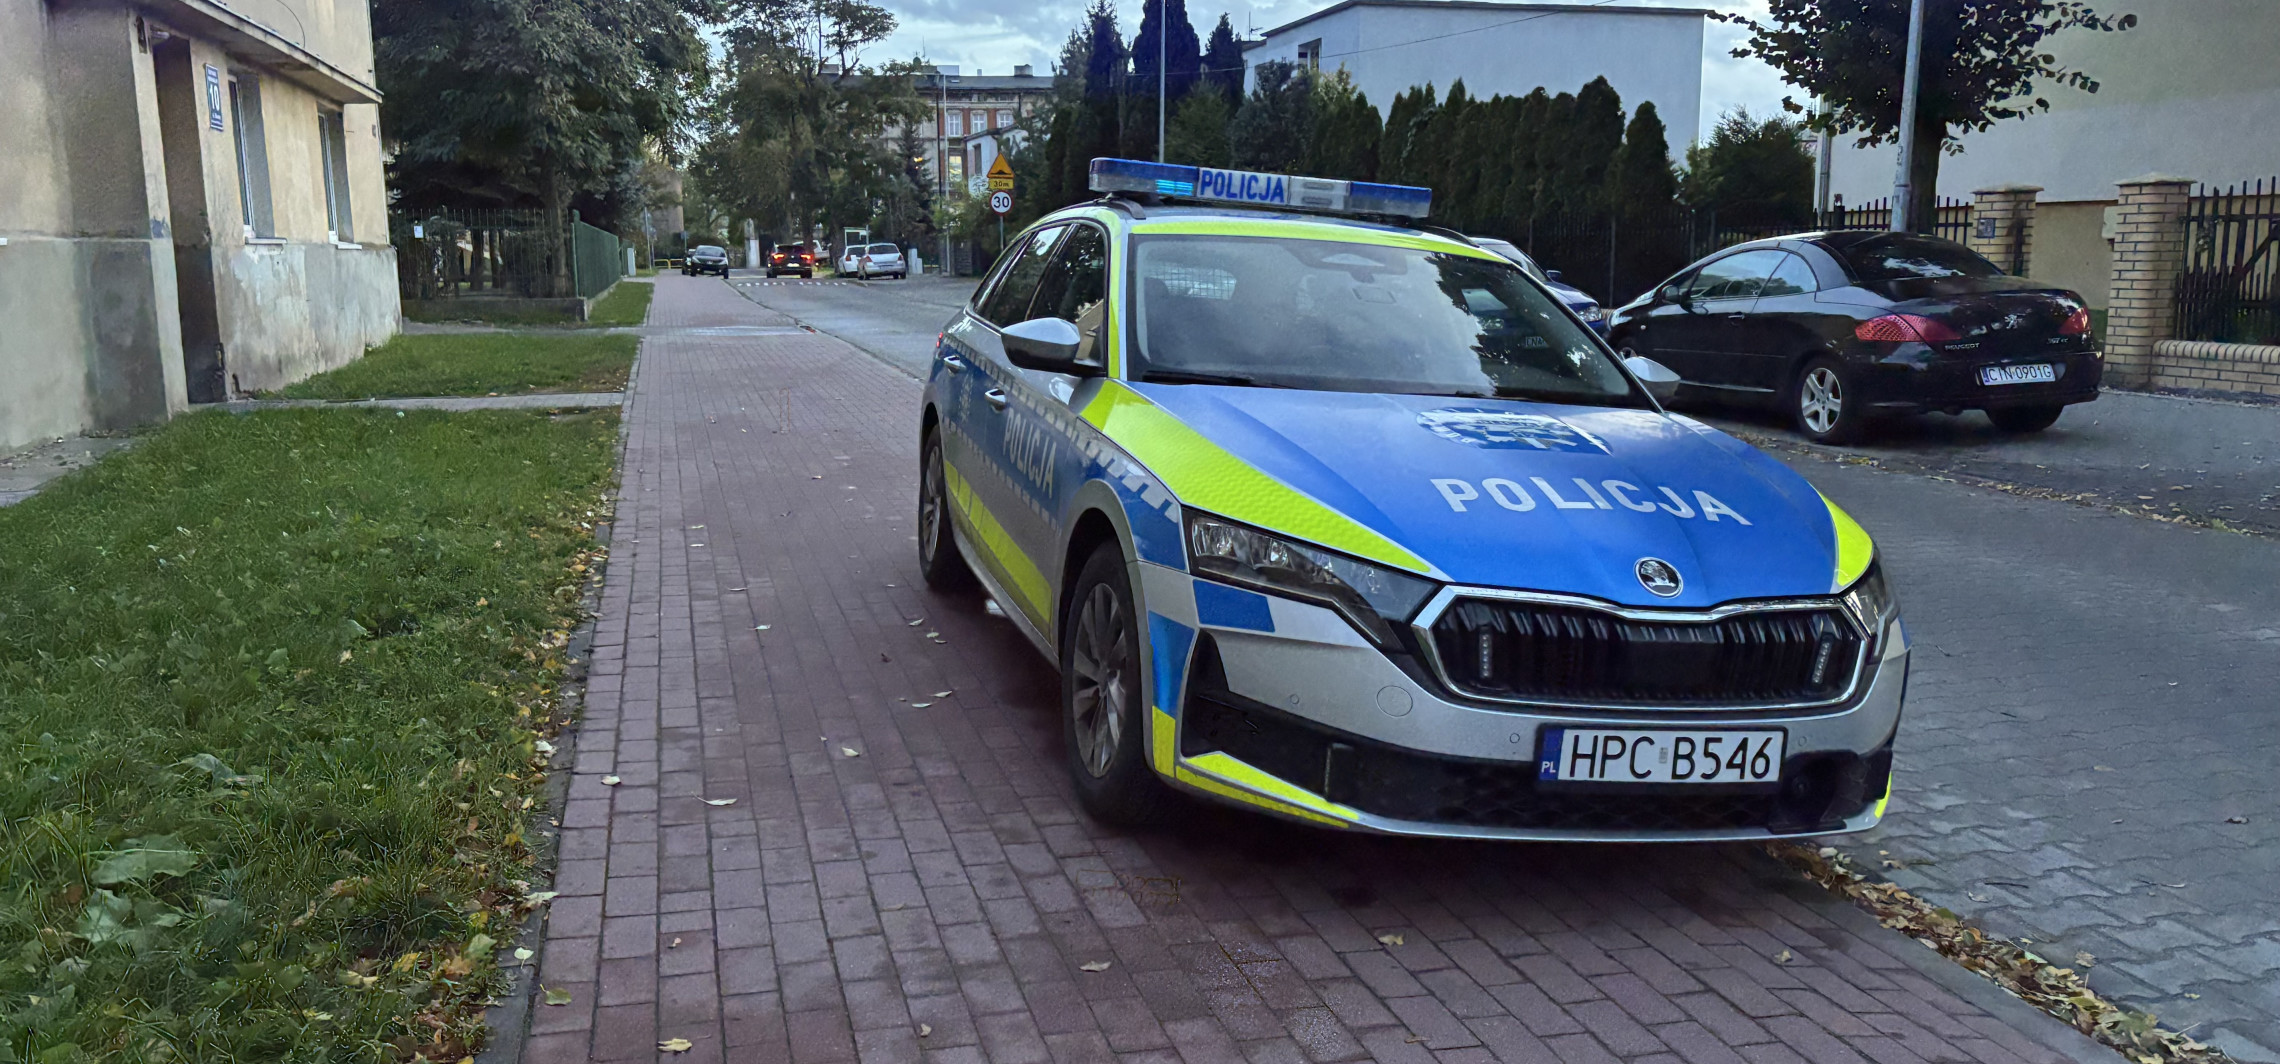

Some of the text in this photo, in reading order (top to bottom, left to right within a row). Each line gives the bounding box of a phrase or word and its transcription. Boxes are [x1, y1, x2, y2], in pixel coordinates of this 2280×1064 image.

[994, 196, 1010, 208] 30
[1201, 170, 1285, 203] POLICJA
[2015, 365, 2052, 379] 0901G
[1003, 408, 1057, 499] POLICJA
[1430, 476, 1753, 526] POLICJA
[1541, 761, 1556, 773] PL
[1569, 735, 1774, 780] HPC B546
